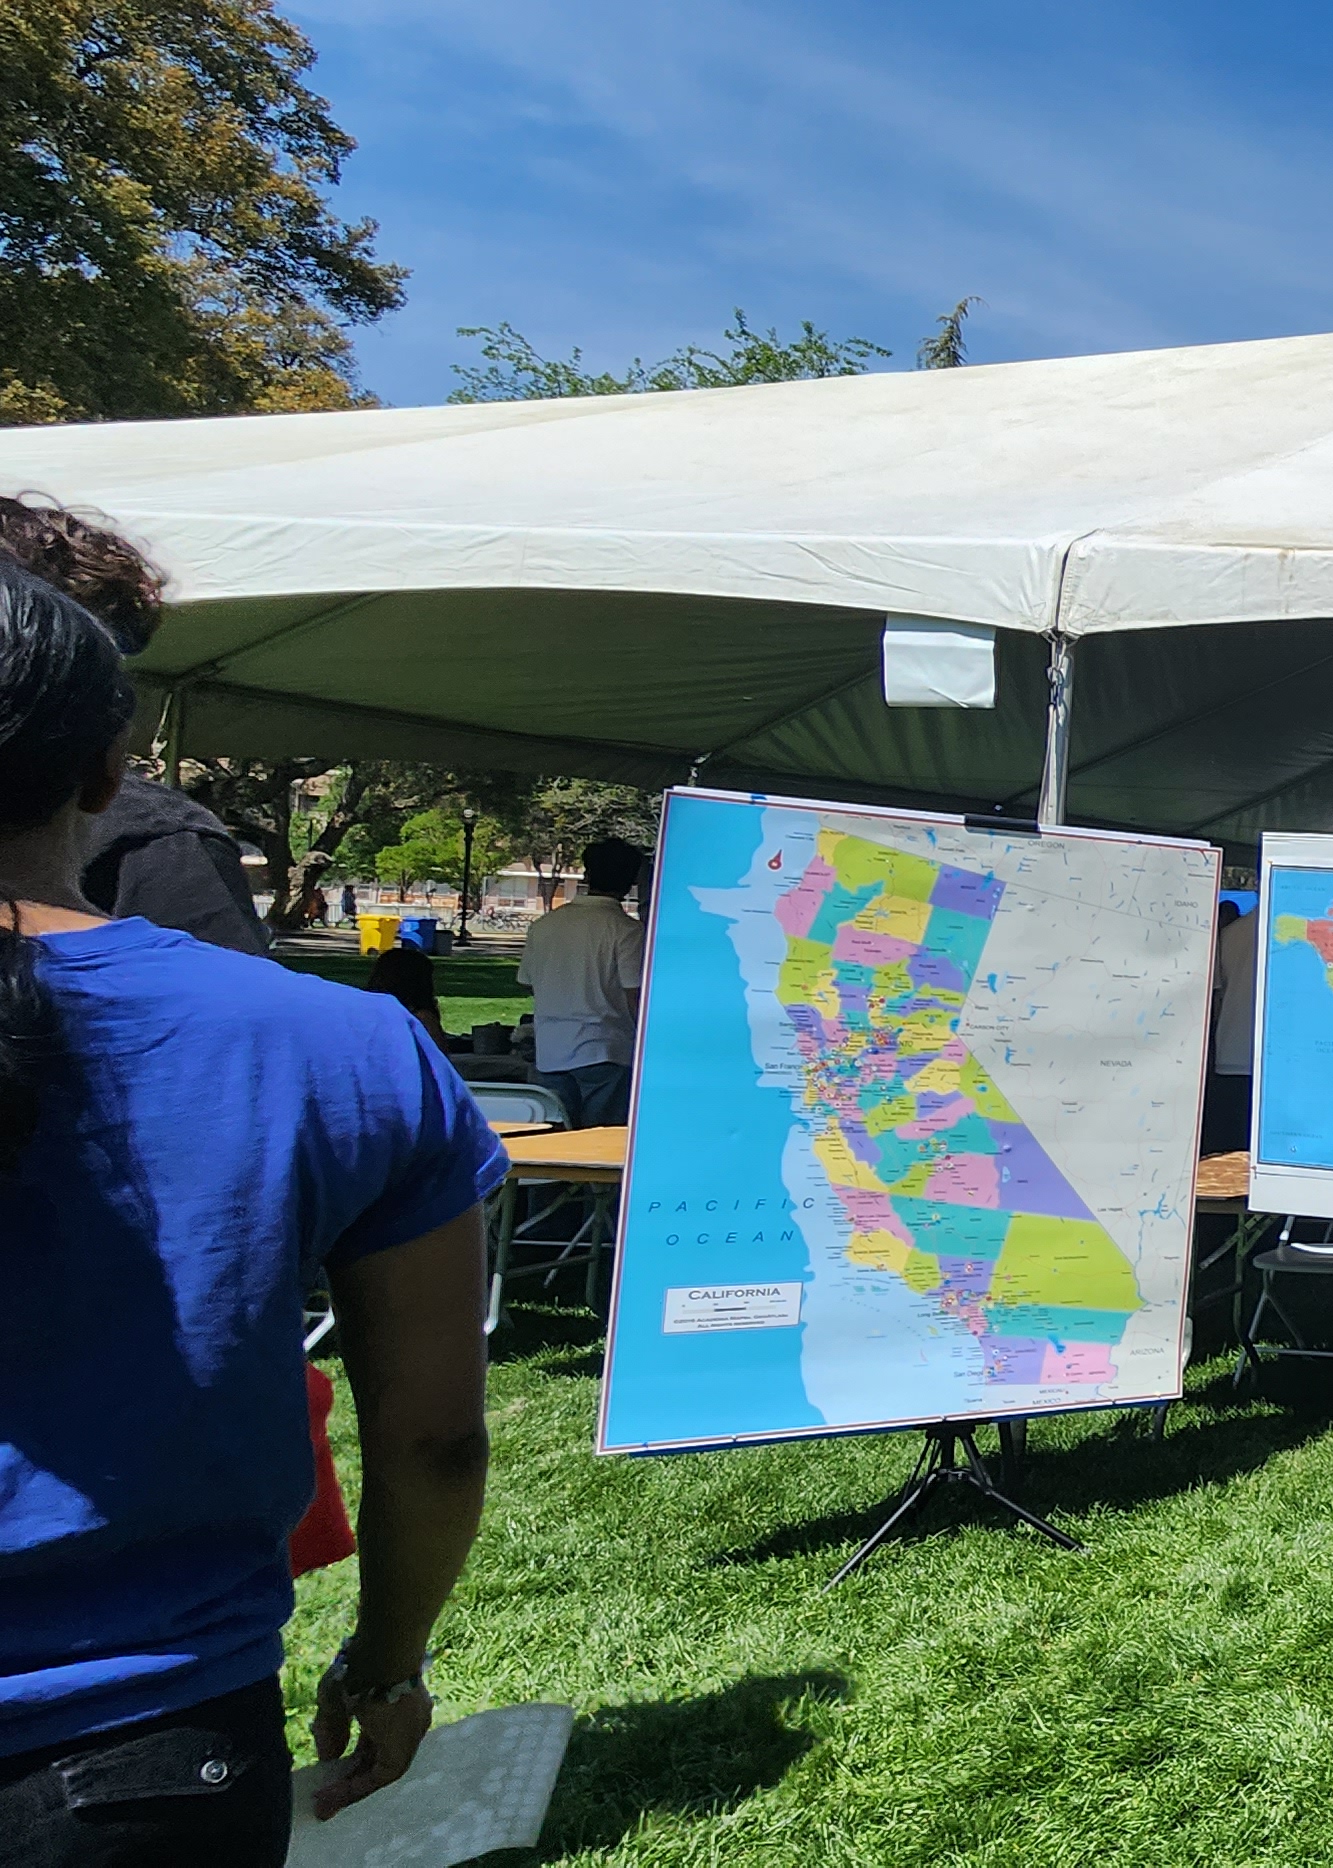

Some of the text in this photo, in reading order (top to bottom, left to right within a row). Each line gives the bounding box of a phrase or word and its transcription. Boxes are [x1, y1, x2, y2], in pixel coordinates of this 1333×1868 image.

[1026, 839, 1065, 850] OREGON
[1174, 900, 1199, 909] IDAHO
[1100, 1059, 1132, 1068] NEVADA
[648, 1197, 815, 1213] PACIFIC
[665, 1230, 794, 1246] OCEAN
[688, 1287, 781, 1300] CALIFORNIA
[1130, 1347, 1165, 1356] ARIZONA
